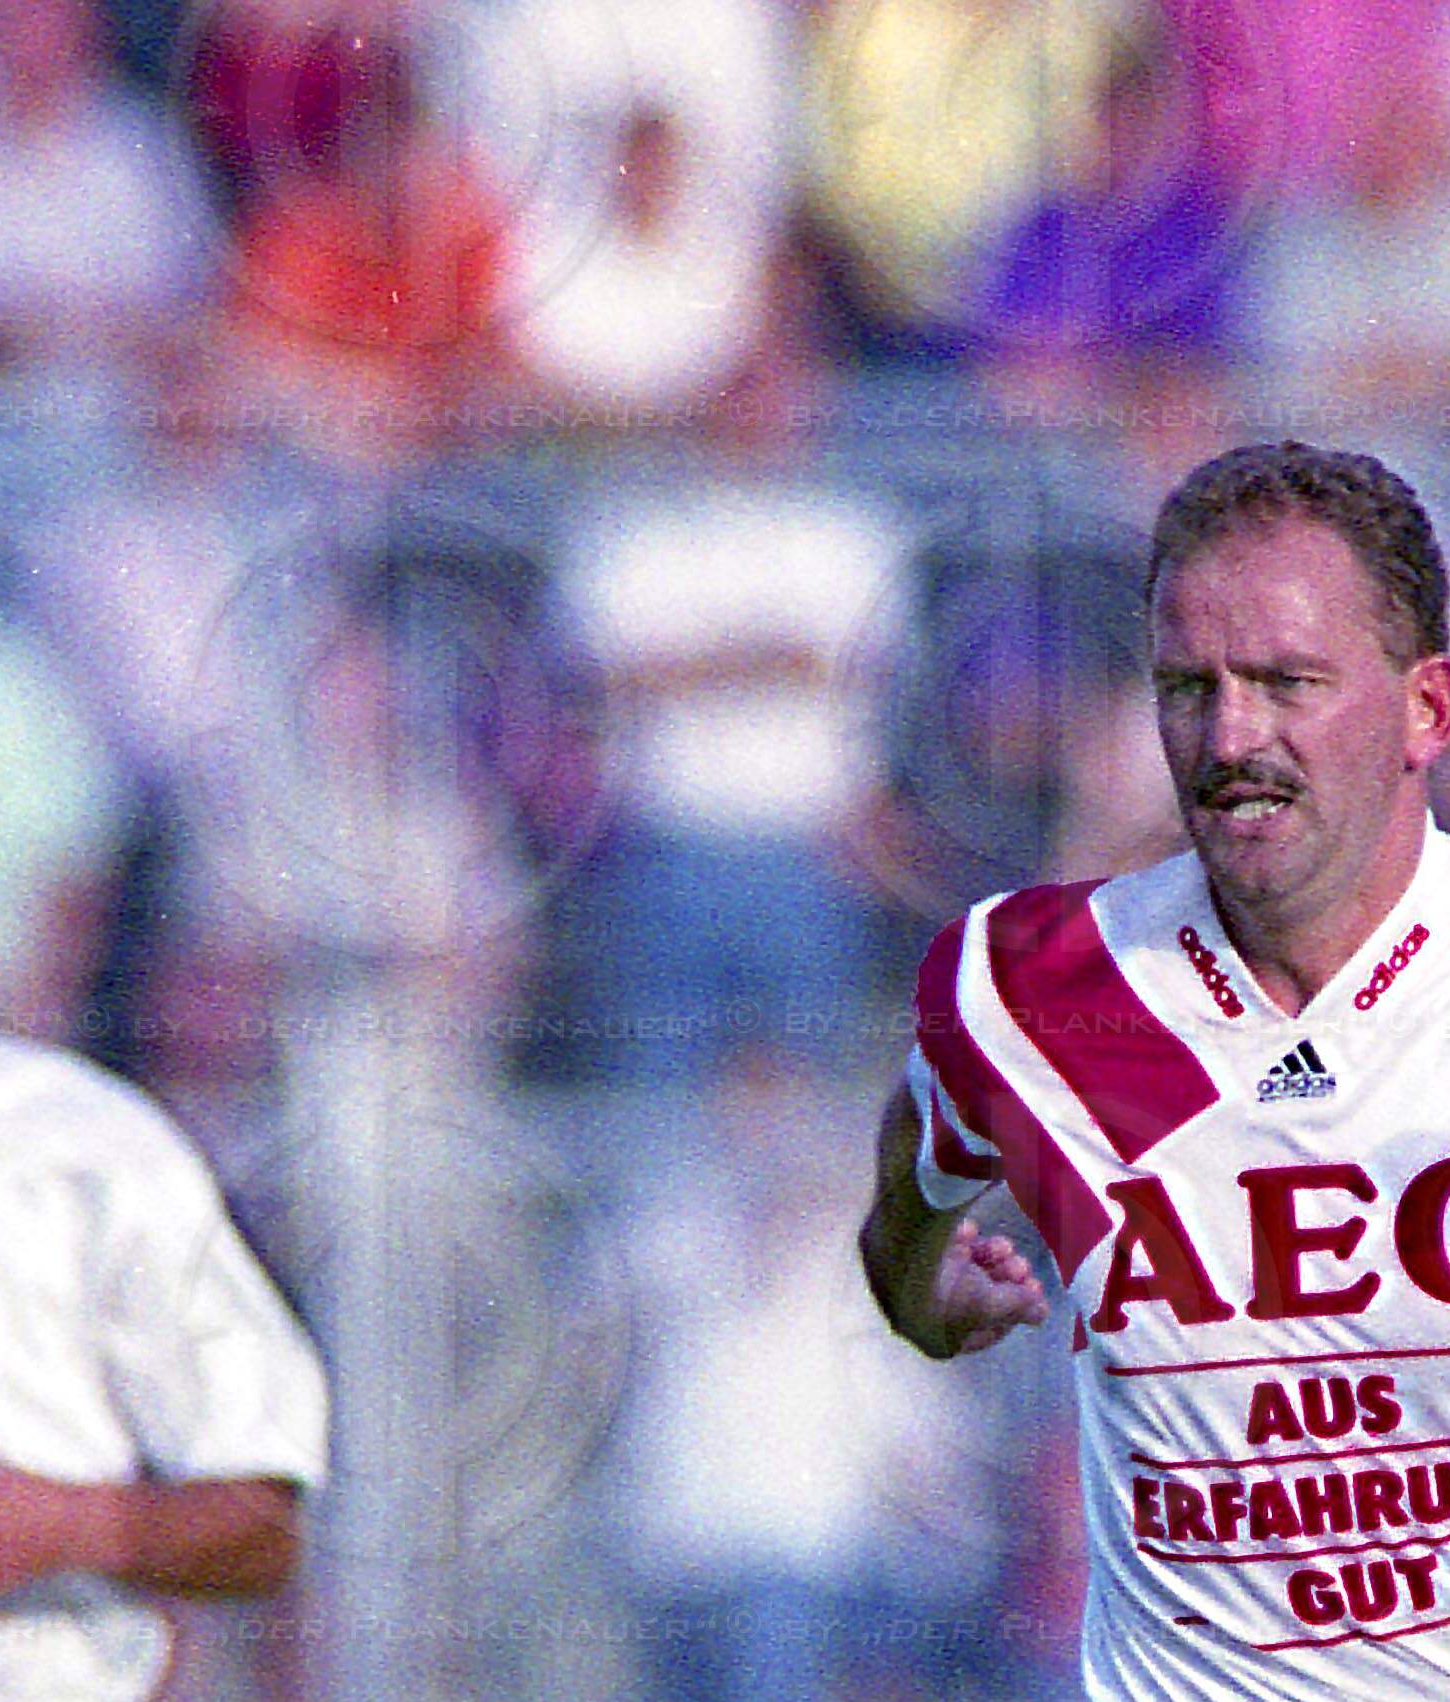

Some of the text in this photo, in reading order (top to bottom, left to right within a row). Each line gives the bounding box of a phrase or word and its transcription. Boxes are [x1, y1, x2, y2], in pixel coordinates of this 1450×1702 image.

[1177, 924, 1246, 1020] adidas
[1353, 922, 1431, 1011] adidas
[1247, 1374, 1403, 1445] AUS
[1286, 1552, 1439, 1627] GUT
